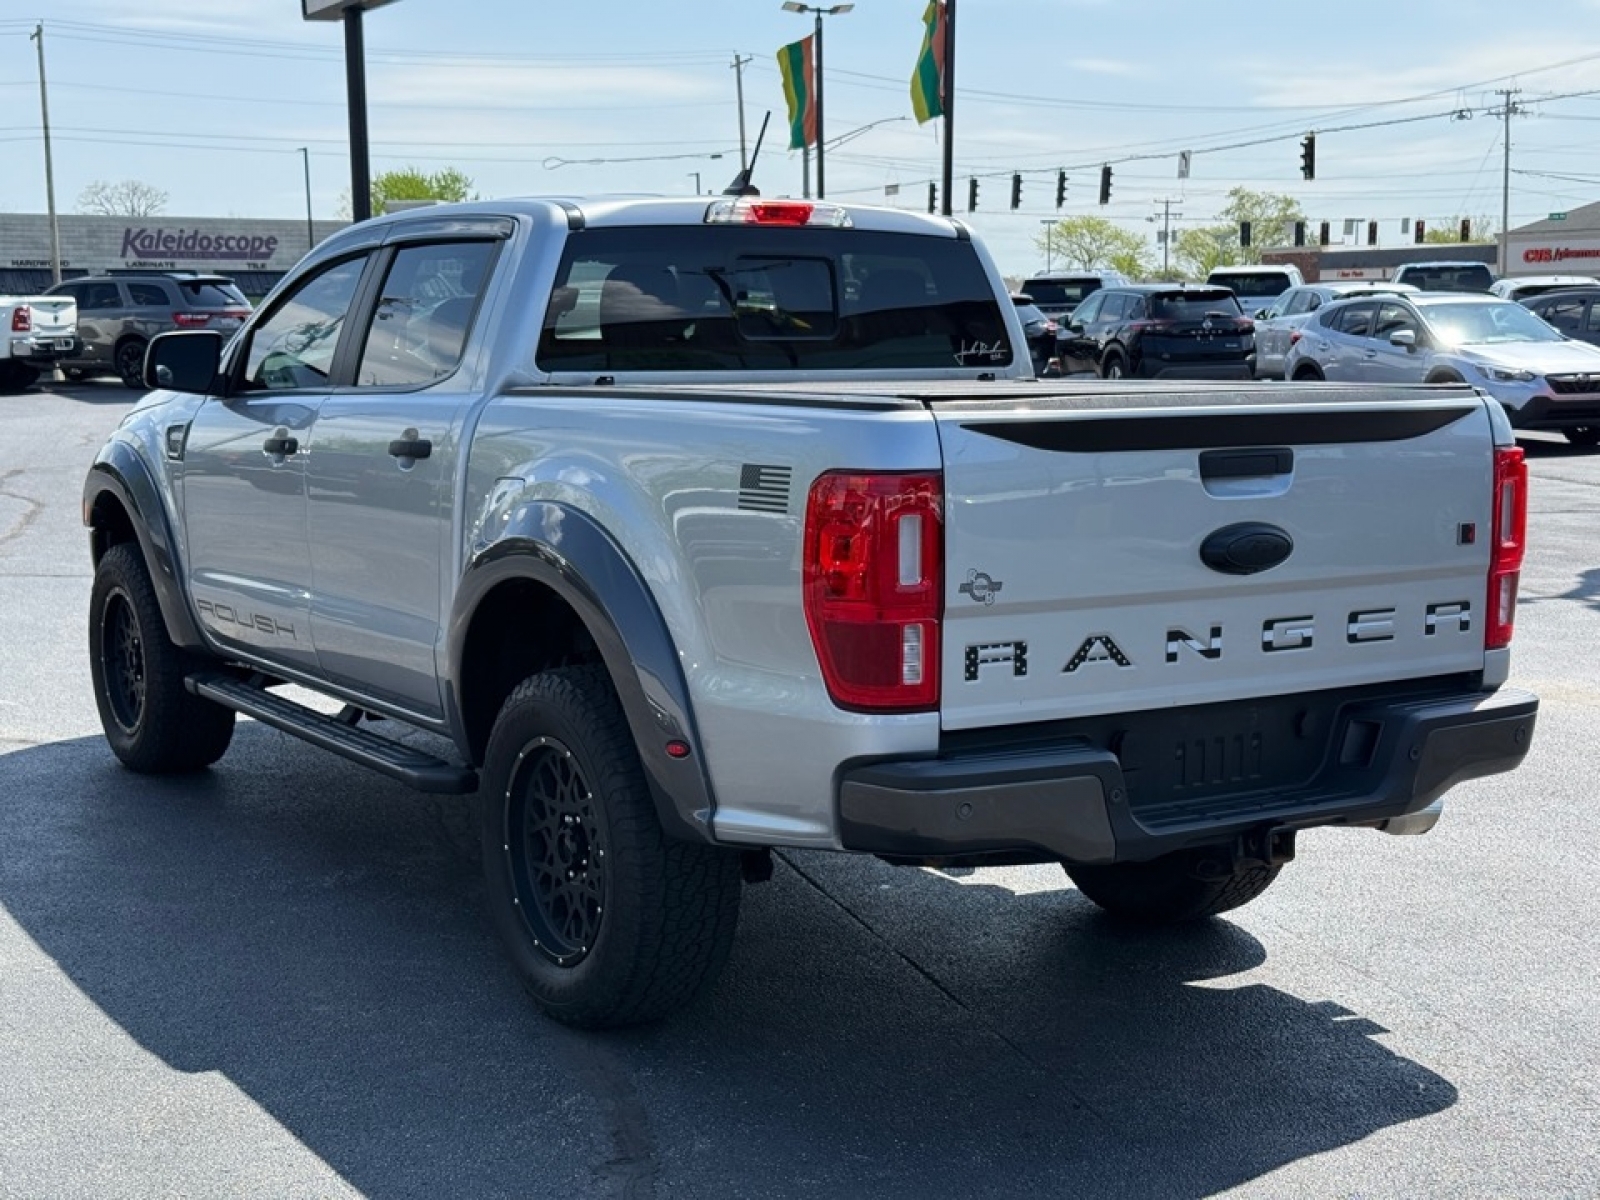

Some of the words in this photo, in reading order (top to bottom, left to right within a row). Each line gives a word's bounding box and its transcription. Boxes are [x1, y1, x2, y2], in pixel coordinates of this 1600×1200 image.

[120, 227, 278, 258] Kaleidoscope
[197, 598, 297, 640] ROUSH
[964, 600, 1472, 682] RANGER
